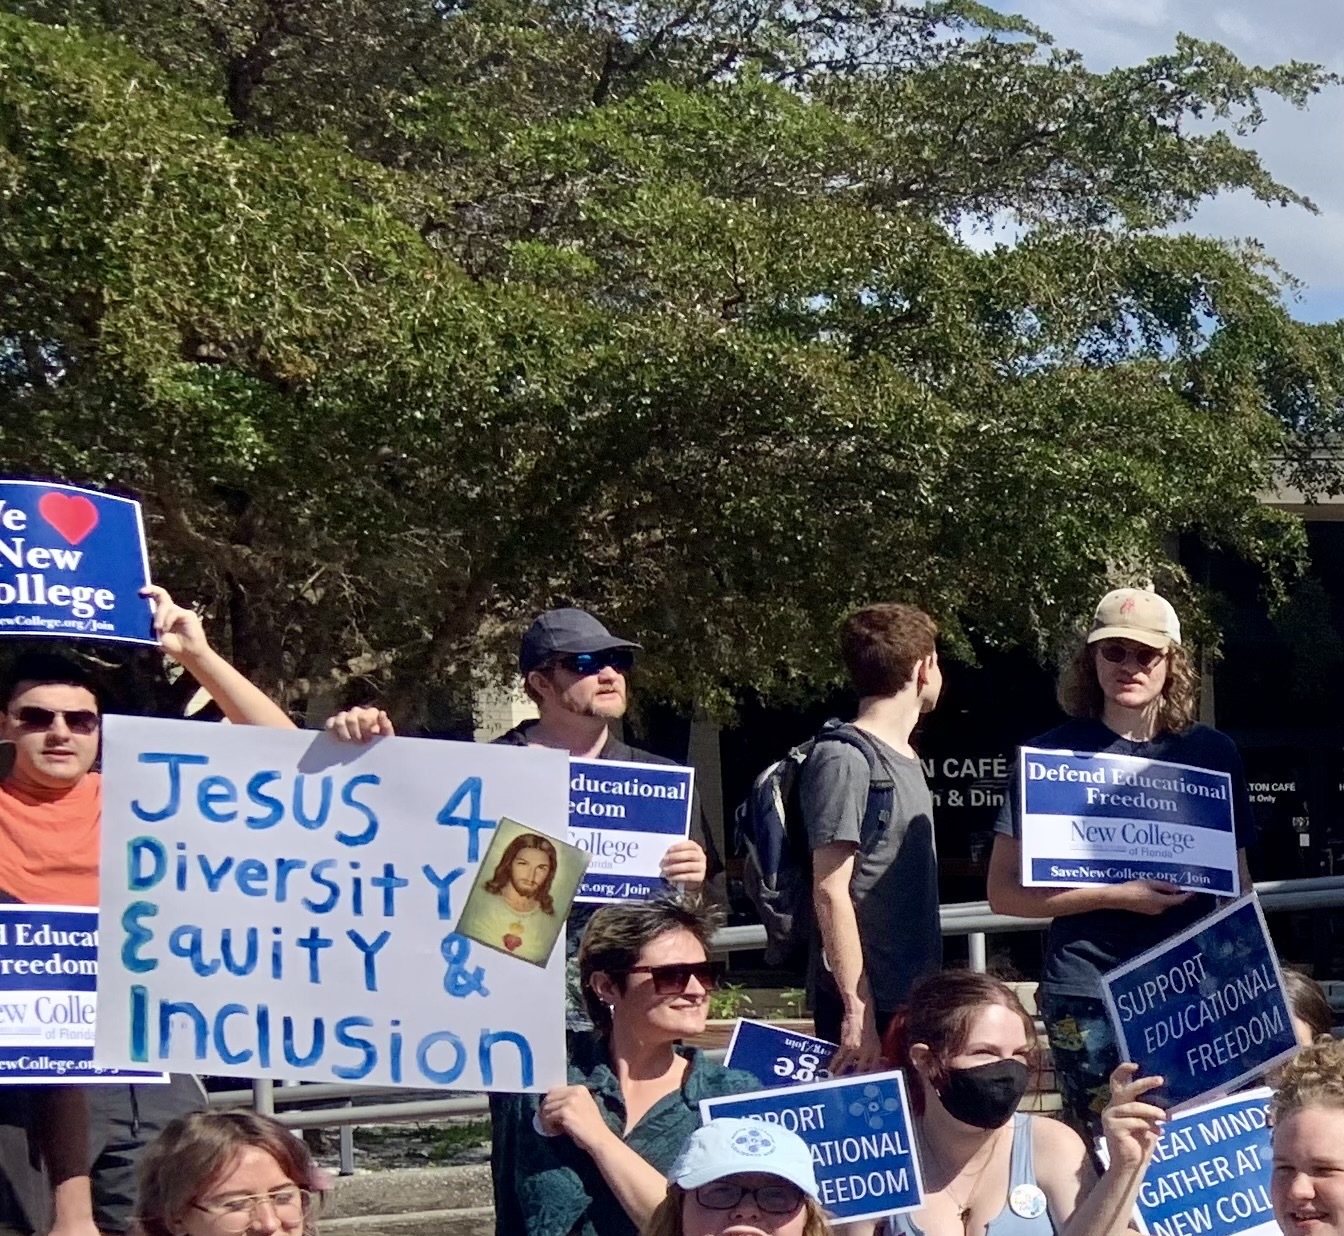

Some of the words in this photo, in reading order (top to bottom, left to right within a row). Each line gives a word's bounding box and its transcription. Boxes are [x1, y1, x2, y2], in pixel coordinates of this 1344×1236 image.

[943, 753, 1008, 779] CAFÉ
[1028, 762, 1105, 784] Defend
[1113, 769, 1227, 801] Educational
[948, 790, 964, 807] &
[1085, 787, 1178, 813] Freedom
[436, 776, 497, 863] 4
[1070, 820, 1119, 844] New
[1122, 822, 1196, 851] College
[1050, 865, 1211, 886] SaveNewCollege.org/Join
[441, 933, 488, 998] &
